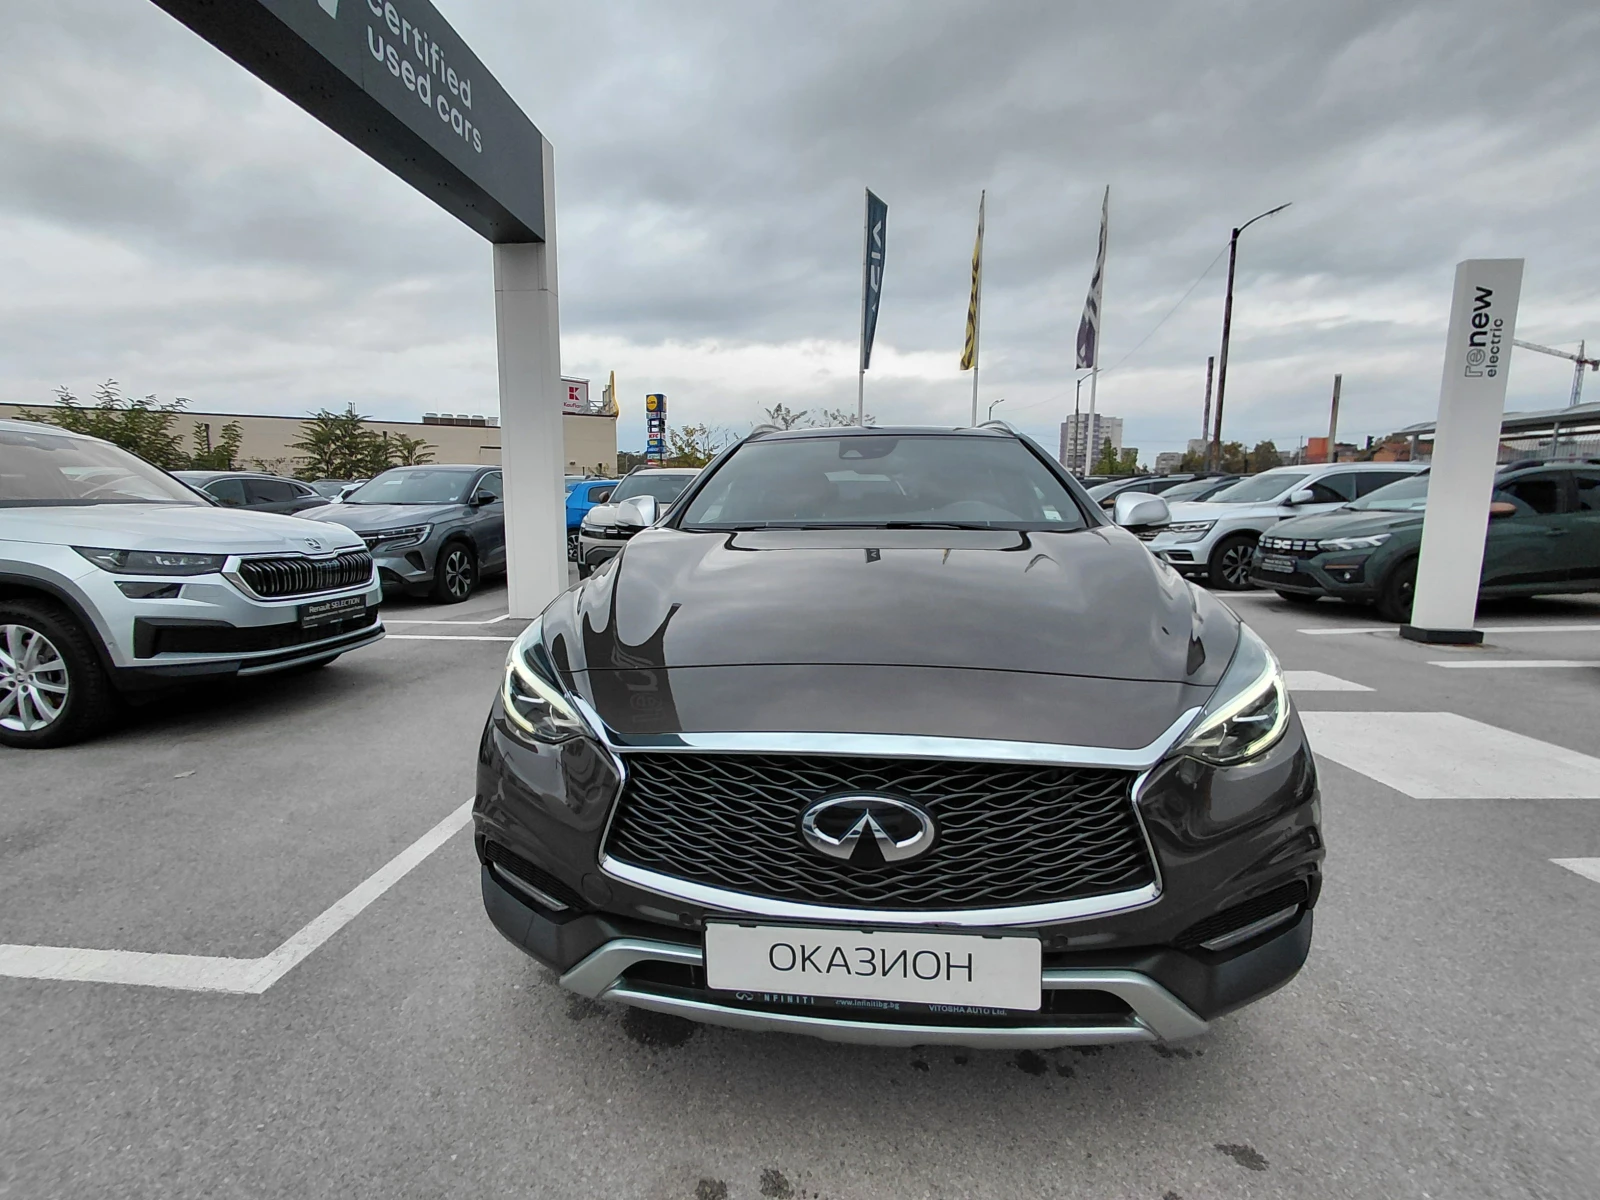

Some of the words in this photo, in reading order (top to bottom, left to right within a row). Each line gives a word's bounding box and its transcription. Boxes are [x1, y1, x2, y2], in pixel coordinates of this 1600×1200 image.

[367, 24, 432, 108] used
[436, 94, 483, 153] cars
[1464, 286, 1494, 377] renew
[1485, 318, 1504, 377] electric
[309, 603, 331, 614] Renault
[331, 597, 361, 609] SELECTION
[768, 942, 973, 983] ОКАЗИОН
[760, 993, 815, 1005] NFINITI
[928, 1004, 966, 1014] VITOSHA
[966, 1007, 990, 1015] AUTO
